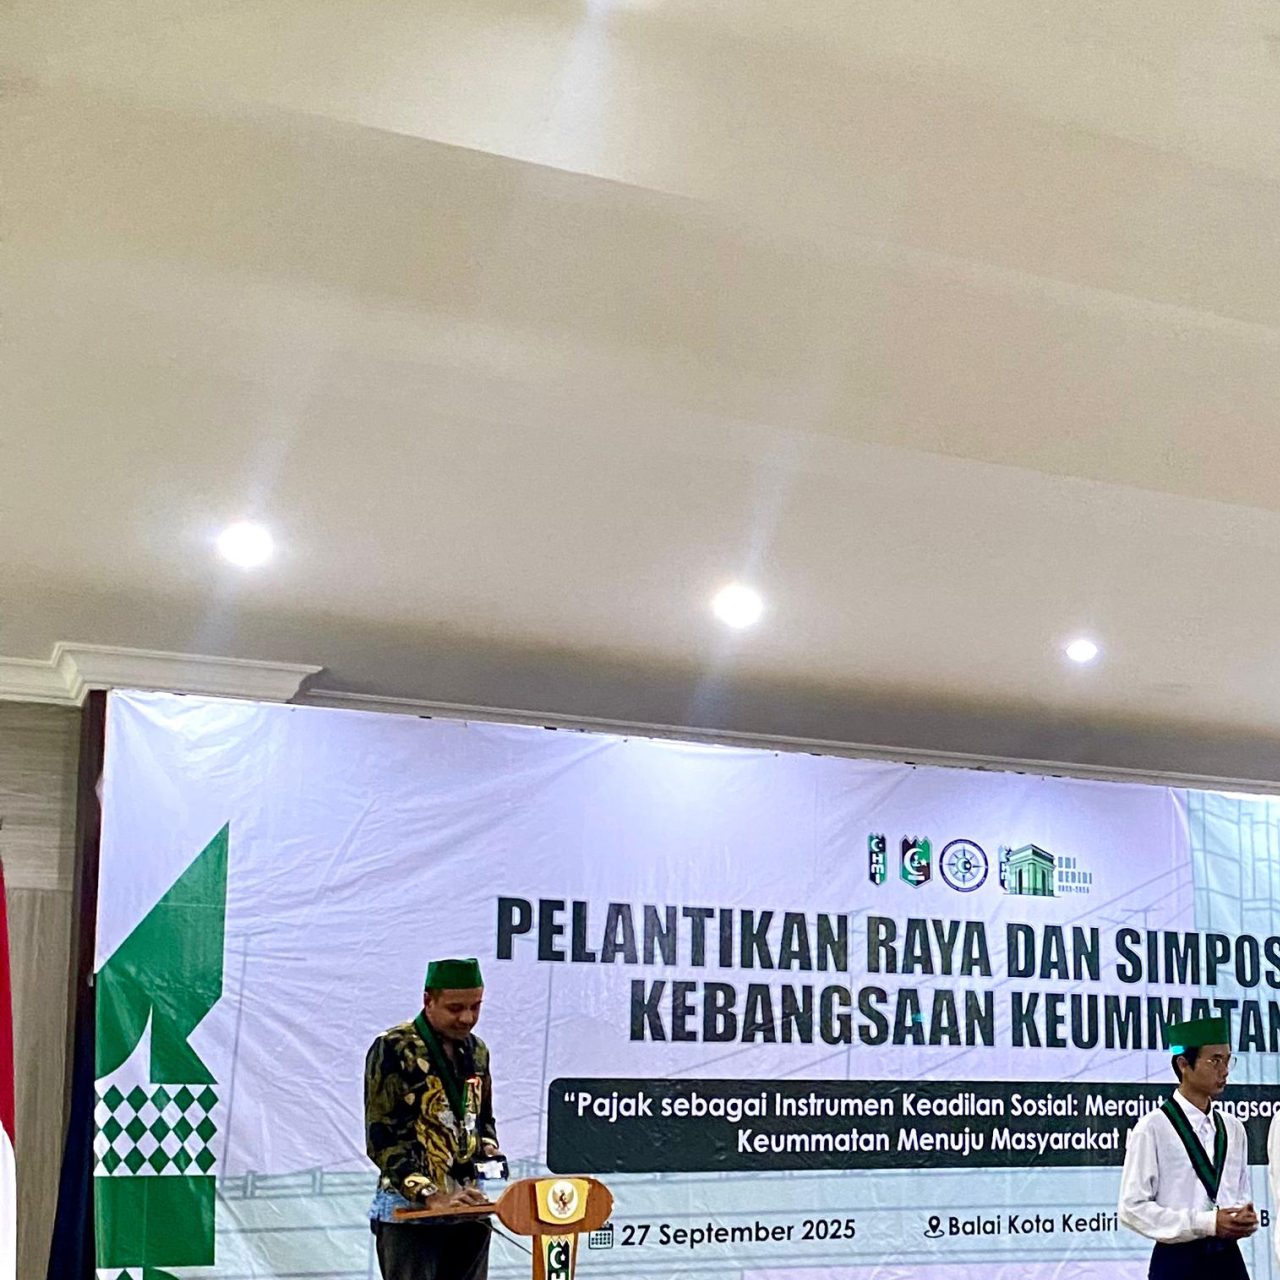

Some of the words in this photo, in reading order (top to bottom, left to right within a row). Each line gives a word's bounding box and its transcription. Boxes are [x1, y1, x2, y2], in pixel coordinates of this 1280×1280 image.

[496, 897, 848, 972] PELANTIKAN
[867, 916, 992, 976] RAYA
[1007, 923, 1100, 980] DAN
[630, 979, 994, 1046] KEBANGSAAN
[564, 1092, 653, 1122] “Pajak
[661, 1092, 767, 1122] sebagai
[776, 1093, 894, 1117] Instrumen
[902, 1093, 1004, 1117] Keadilan
[1011, 1093, 1078, 1117] Sosial:
[737, 1128, 889, 1152] Keummatan
[897, 1127, 984, 1156] Menuju
[991, 1127, 1119, 1155] Masyarakat
[621, 1225, 650, 1246] 27
[659, 1221, 794, 1249] September
[801, 1219, 856, 1240] 2025
[949, 1214, 1001, 1236] Balai
[1008, 1214, 1054, 1235] Kota
[1062, 1212, 1118, 1232] Kediri
